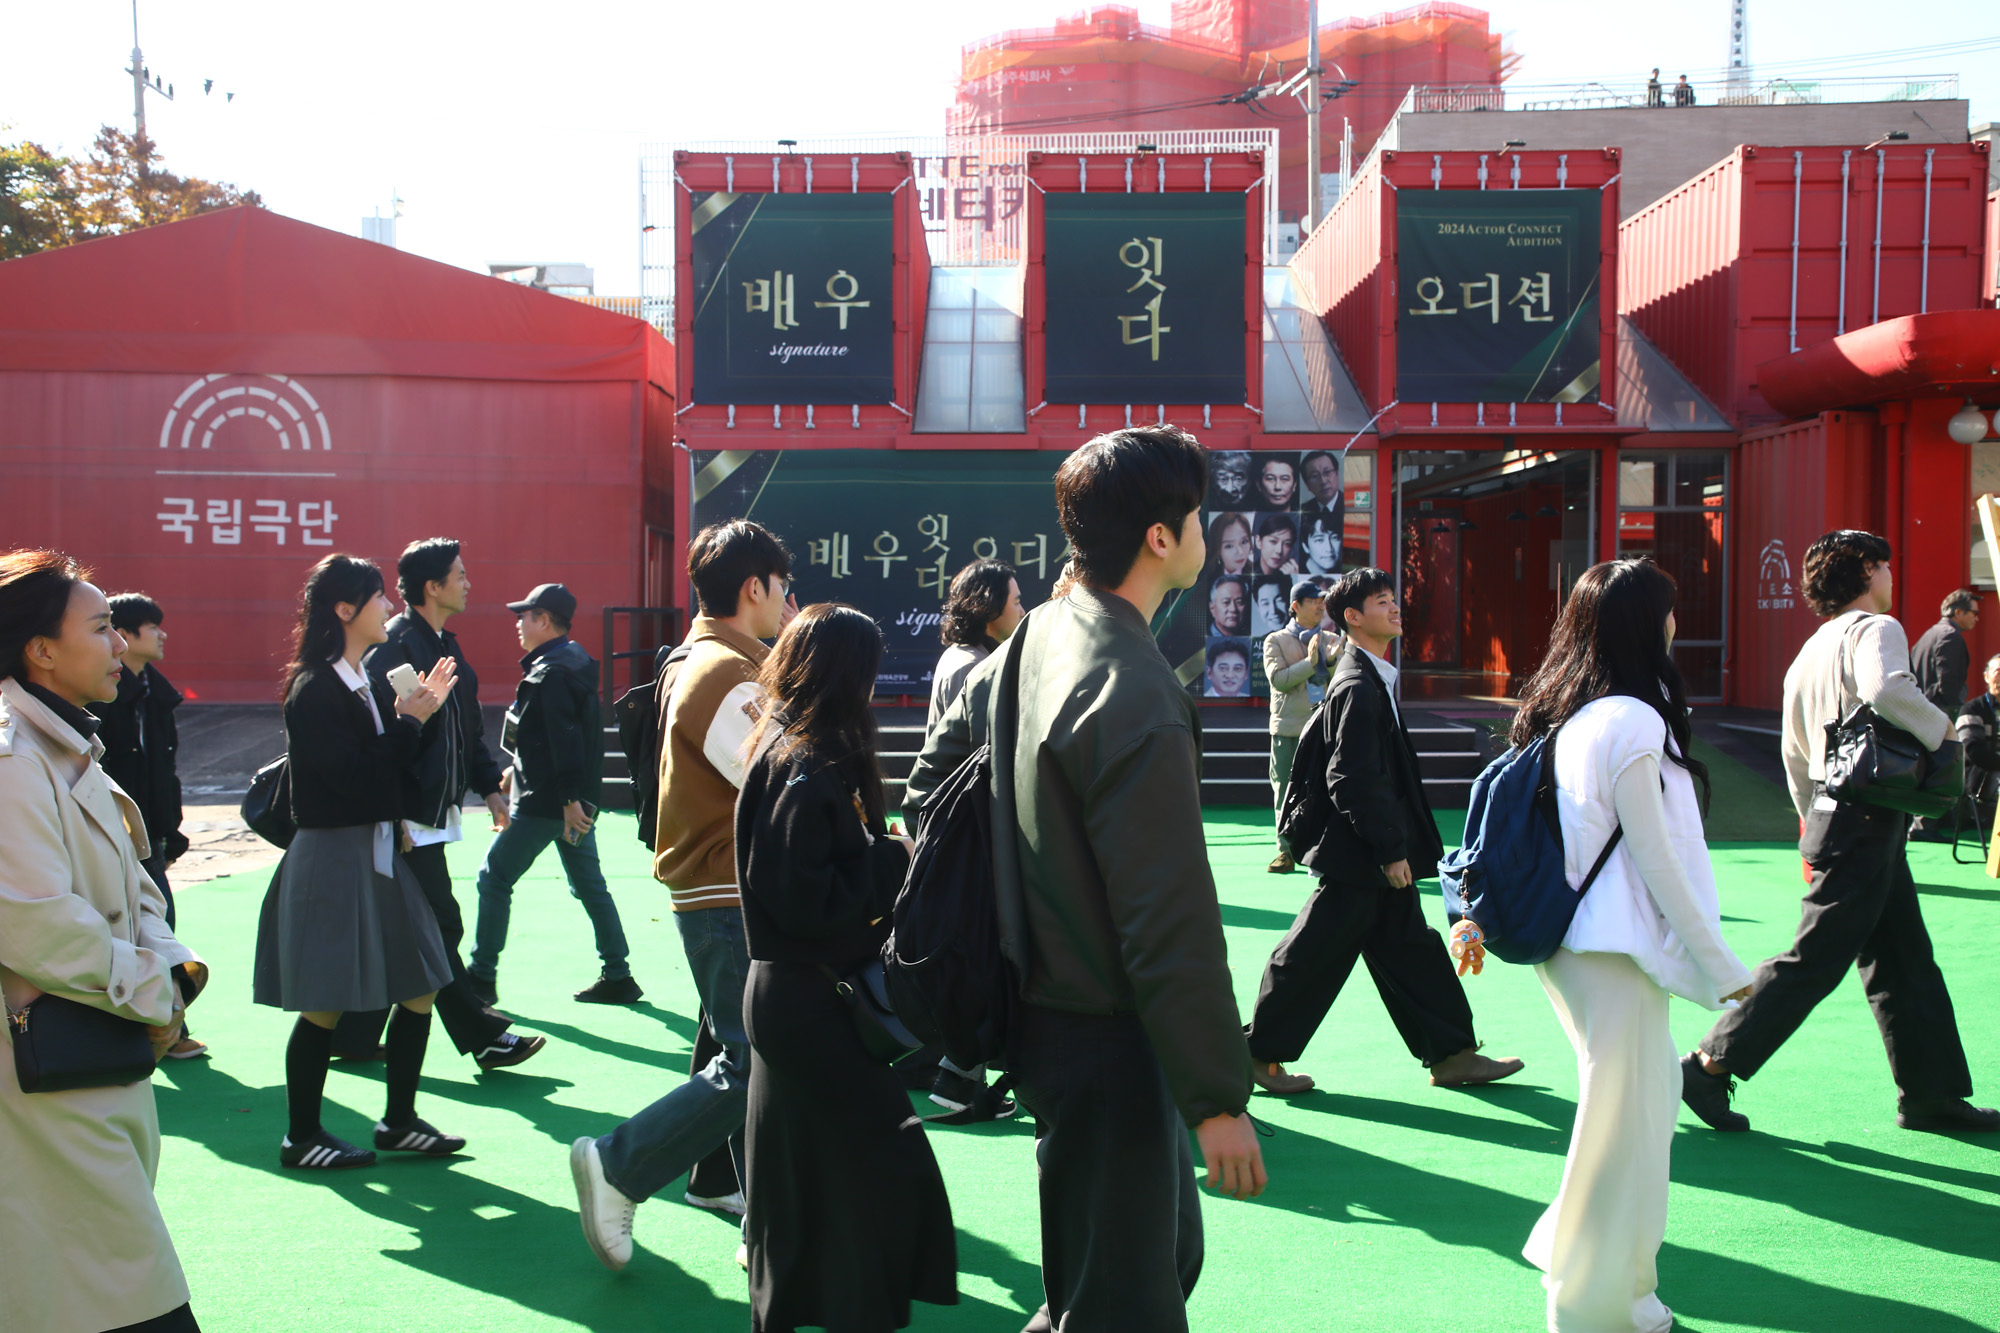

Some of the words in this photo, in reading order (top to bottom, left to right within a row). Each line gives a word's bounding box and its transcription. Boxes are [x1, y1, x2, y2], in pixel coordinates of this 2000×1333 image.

[912, 156, 979, 178] TTE
[986, 163, 1026, 176] ren
[1438, 223, 1465, 235] 2024
[1466, 224, 1506, 235] ACTOR
[1507, 223, 1563, 235] CONNECT
[1506, 236, 1563, 247] AUDITION
[741, 269, 870, 331] 배우
[1117, 236, 1171, 361] 잇다
[1408, 271, 1554, 324] 오디션
[769, 342, 850, 364] signature
[156, 497, 339, 546] 국립극단
[807, 530, 909, 579] 배우
[915, 513, 952, 600] 잇다
[896, 607, 945, 637] sign
